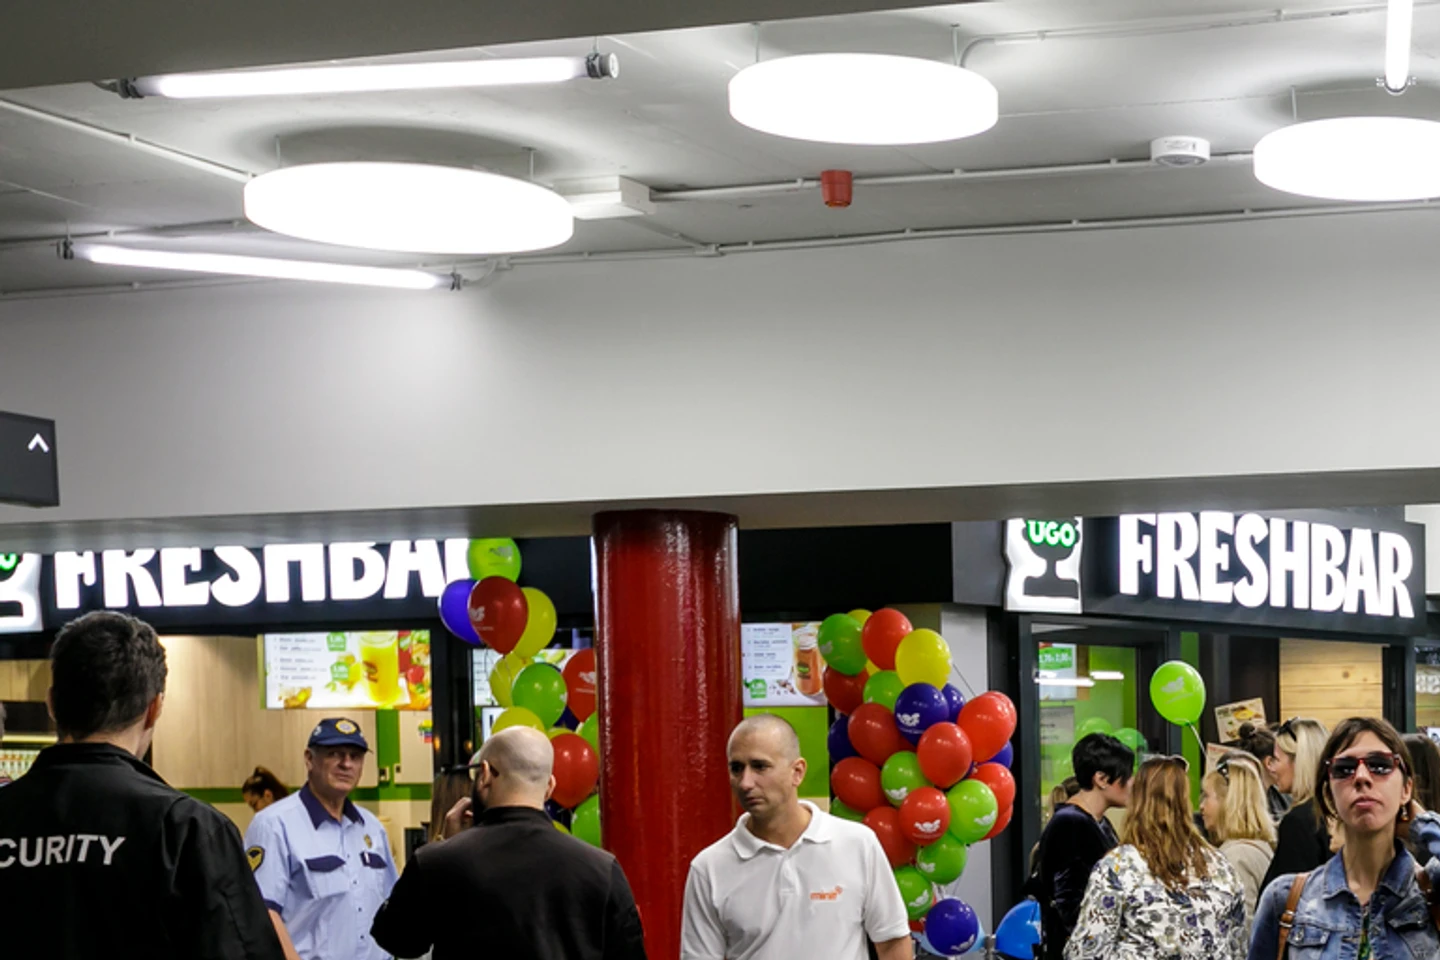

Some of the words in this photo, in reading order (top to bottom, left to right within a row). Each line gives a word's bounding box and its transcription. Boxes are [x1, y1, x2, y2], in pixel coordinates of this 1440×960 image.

[1028, 519, 1076, 547] UGO
[1119, 510, 1414, 618] FRESHBAR
[0, 834, 126, 868] CURITY
